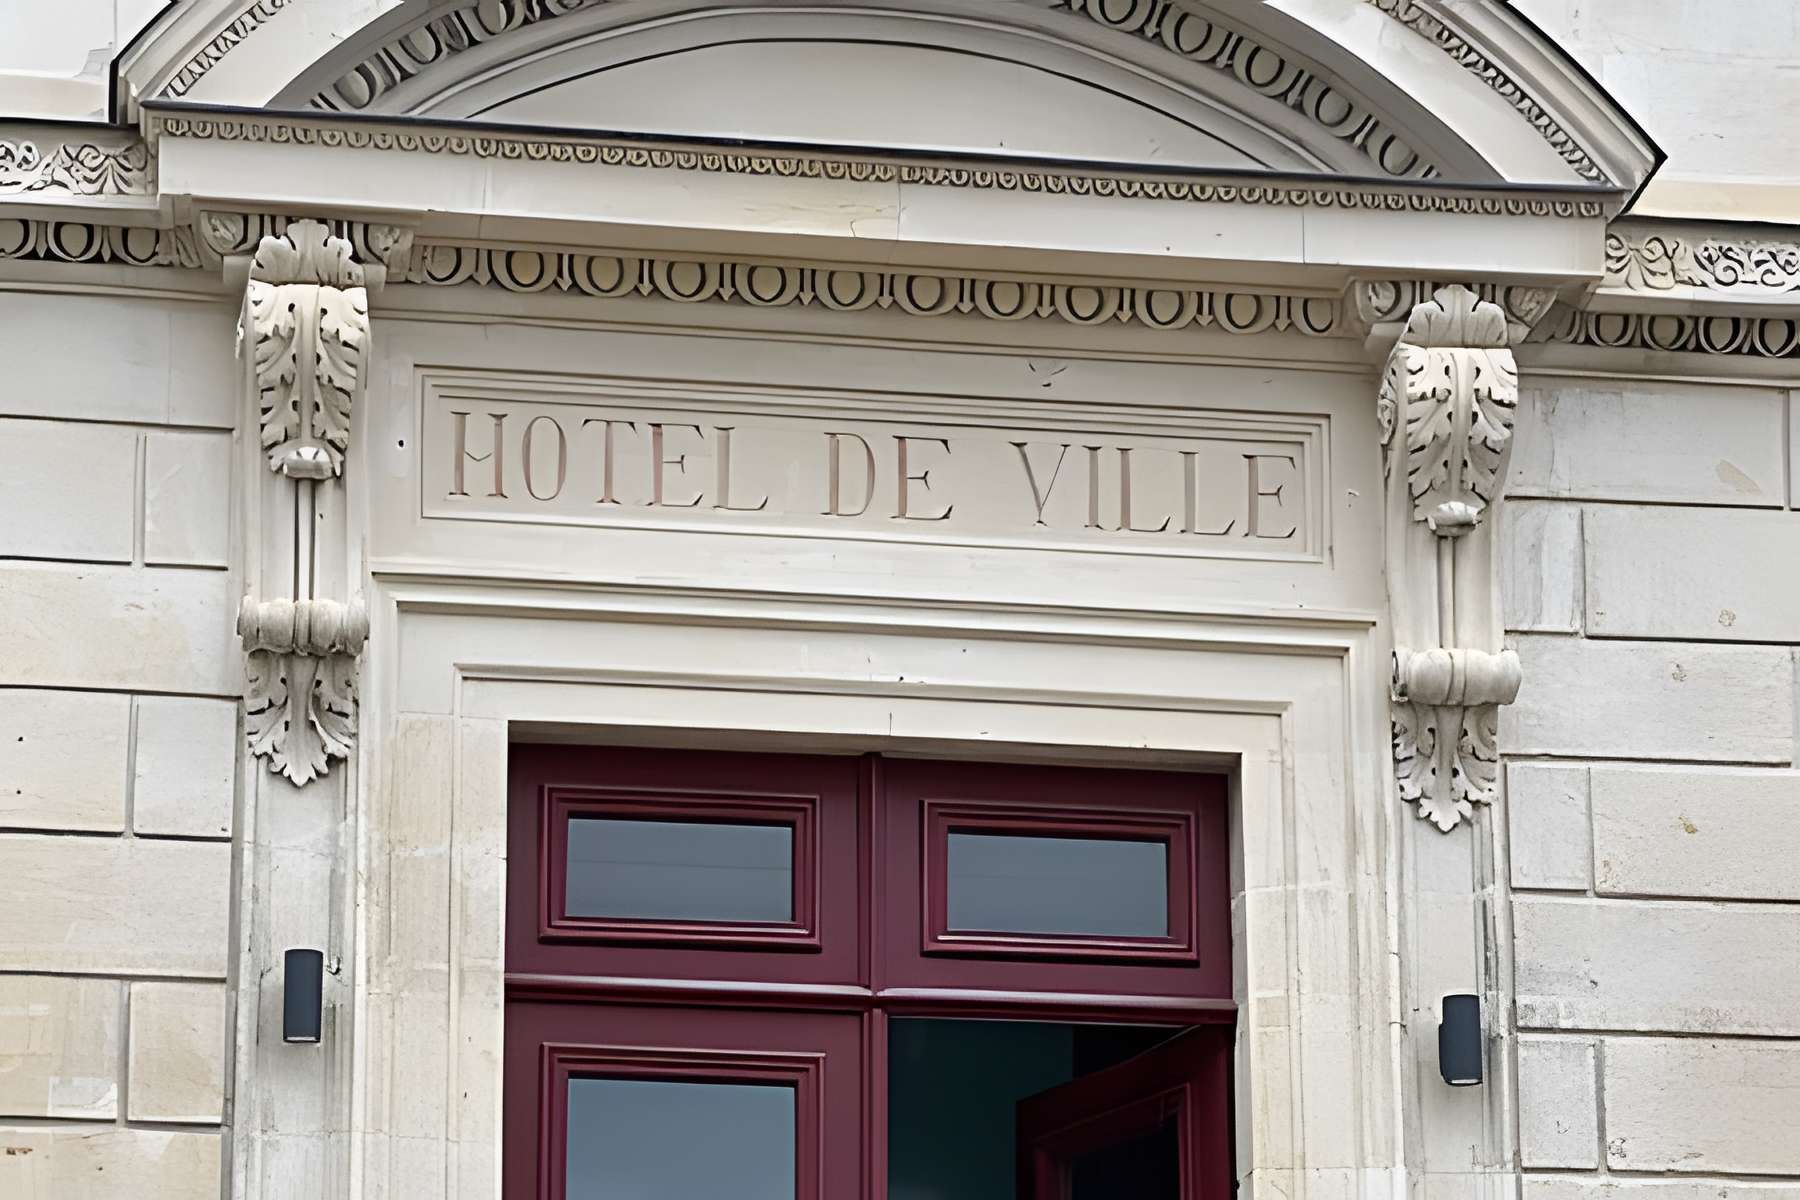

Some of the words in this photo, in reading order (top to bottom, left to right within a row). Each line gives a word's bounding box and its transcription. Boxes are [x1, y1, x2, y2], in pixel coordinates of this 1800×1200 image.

[447, 410, 769, 513] HOTEL
[822, 431, 954, 521] DE
[1007, 440, 1298, 539] VILLE
